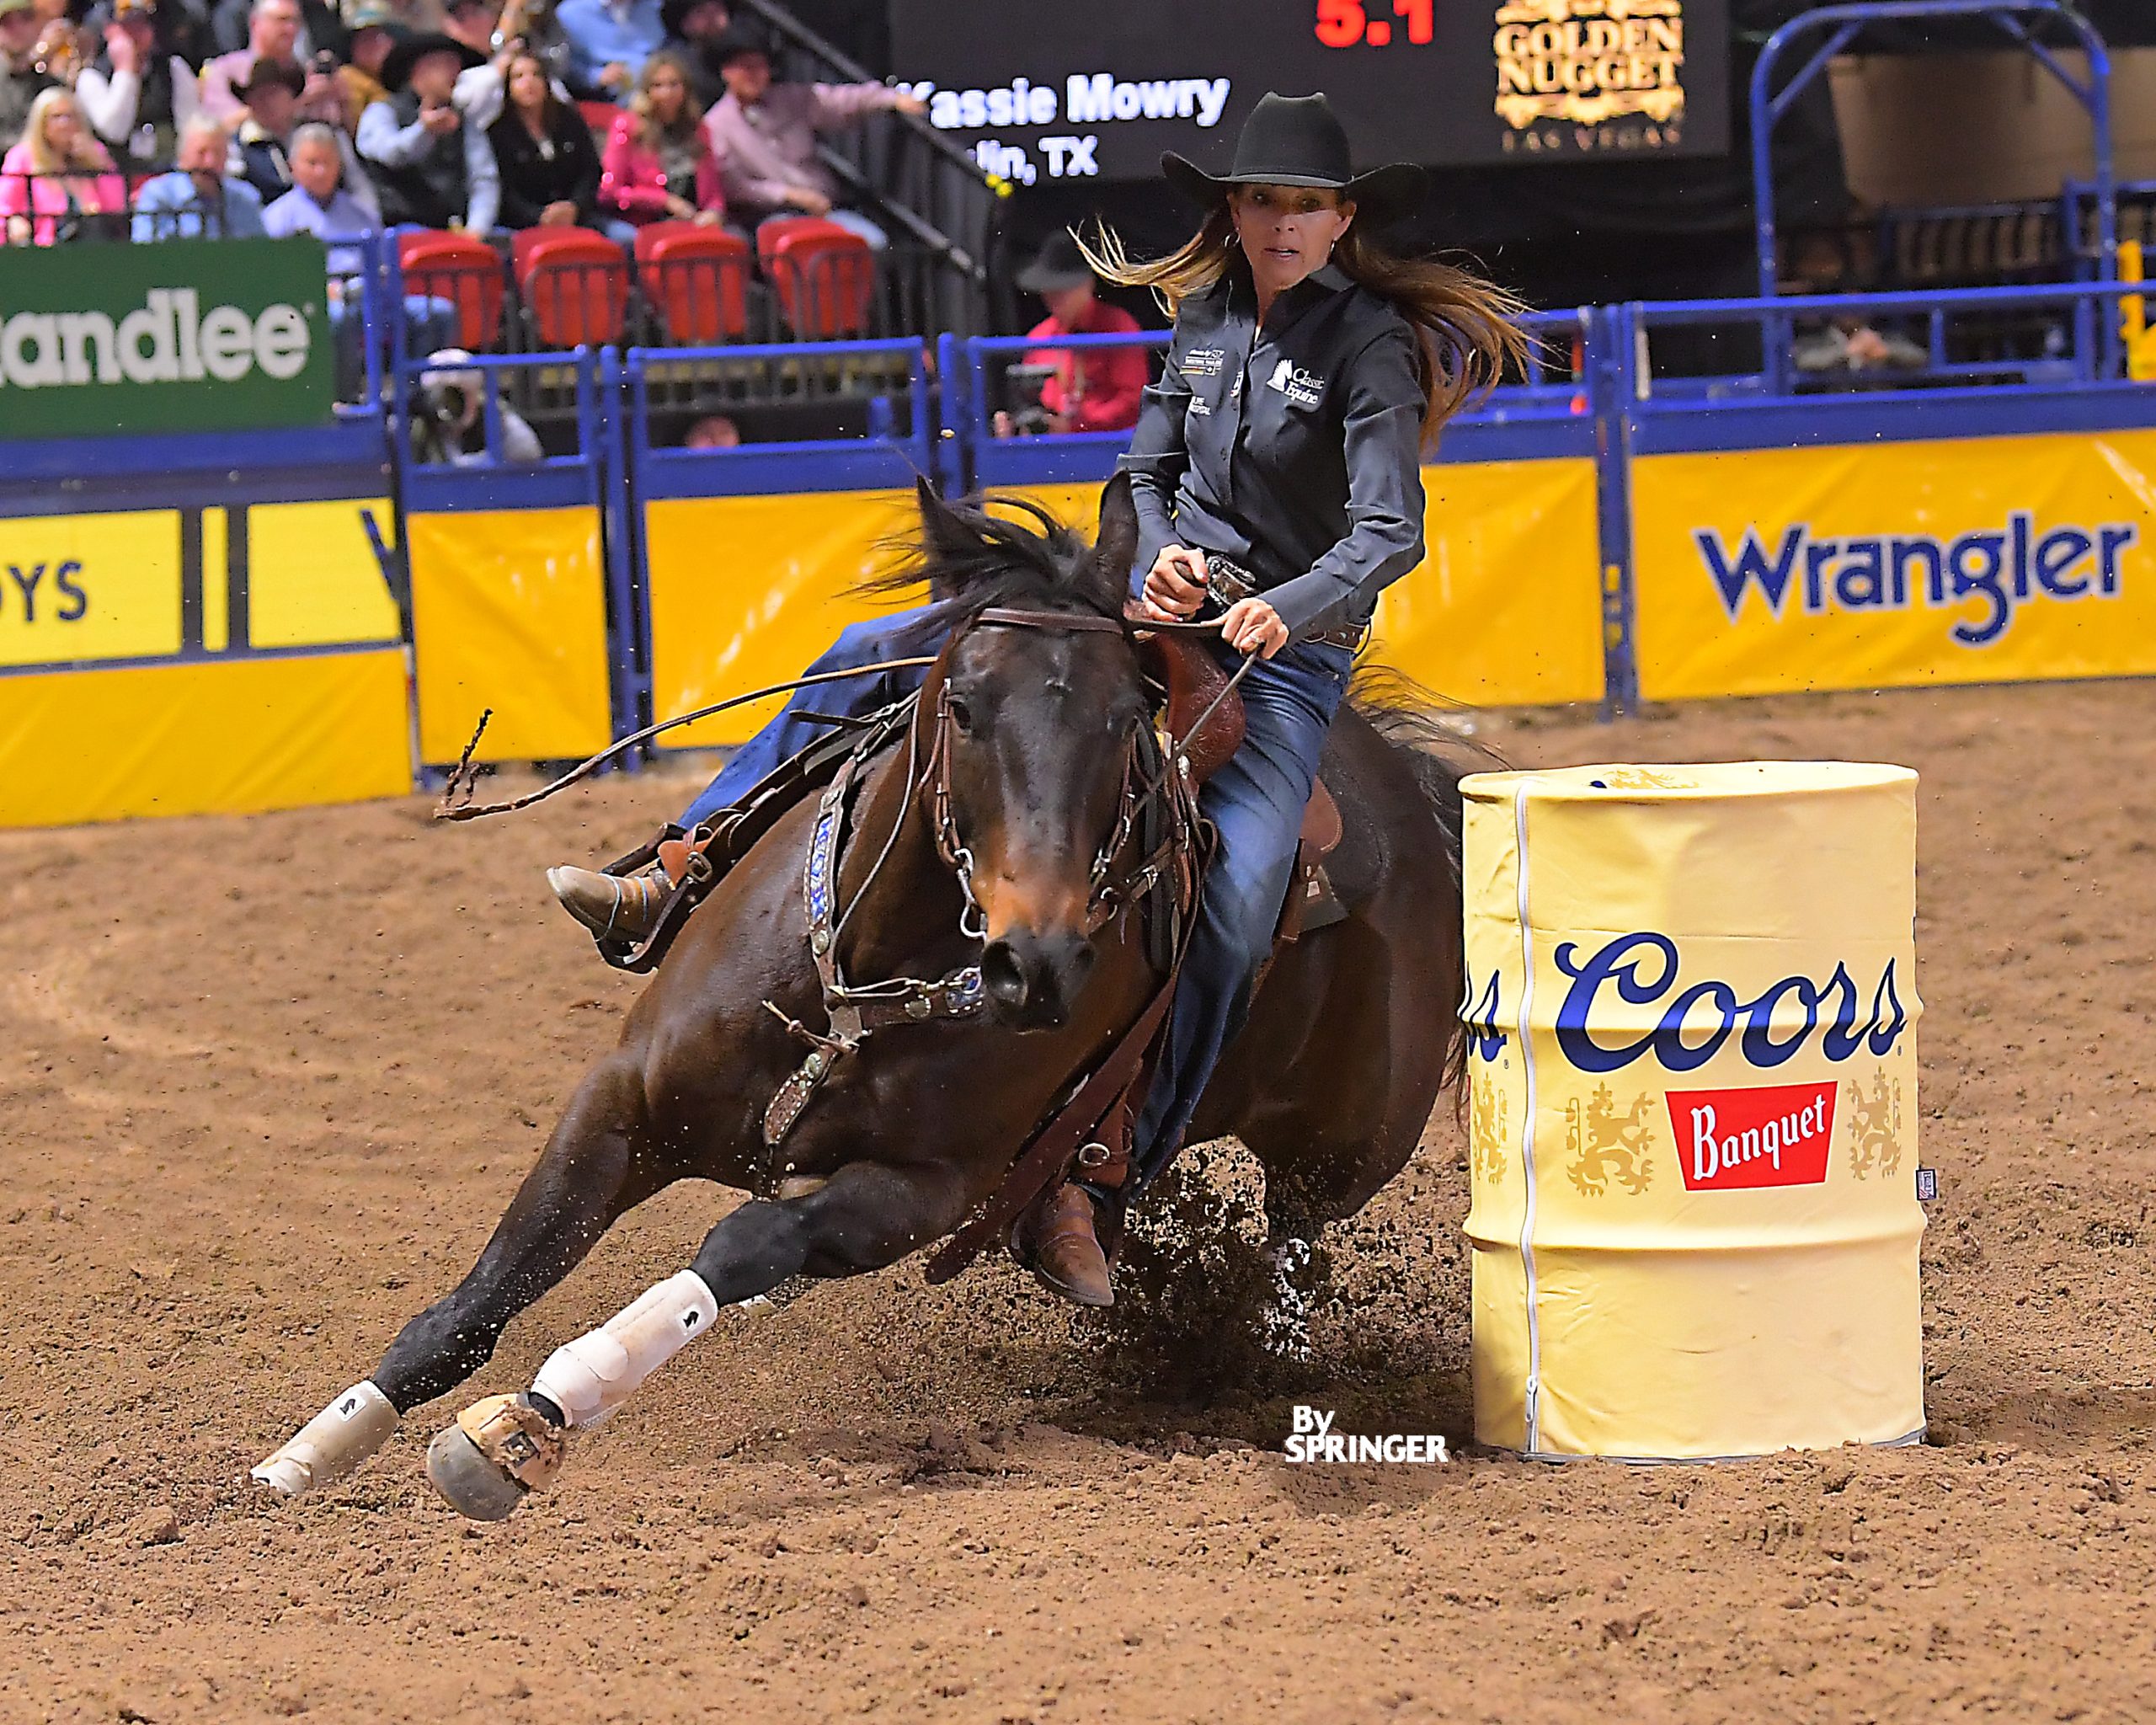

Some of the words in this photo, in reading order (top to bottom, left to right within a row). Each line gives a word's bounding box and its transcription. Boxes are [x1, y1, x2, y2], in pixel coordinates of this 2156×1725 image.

[1315, 0, 1433, 48] 5.1
[1494, 18, 1683, 59] GOLDEN
[1496, 52, 1684, 93] NUGGET
[1066, 72, 1231, 127] Mowry
[966, 139, 1037, 186] lin,
[1038, 135, 1098, 178] TX
[1502, 128, 1561, 153] LAS
[1573, 126, 1683, 152] VEGAS
[0, 287, 312, 390] andlee
[1284, 381, 1319, 404] Equine
[0, 560, 88, 623] YS
[1693, 512, 2135, 646] Wrangler
[1555, 932, 1908, 1072] Coors
[1690, 1092, 1828, 1182] Banquet
